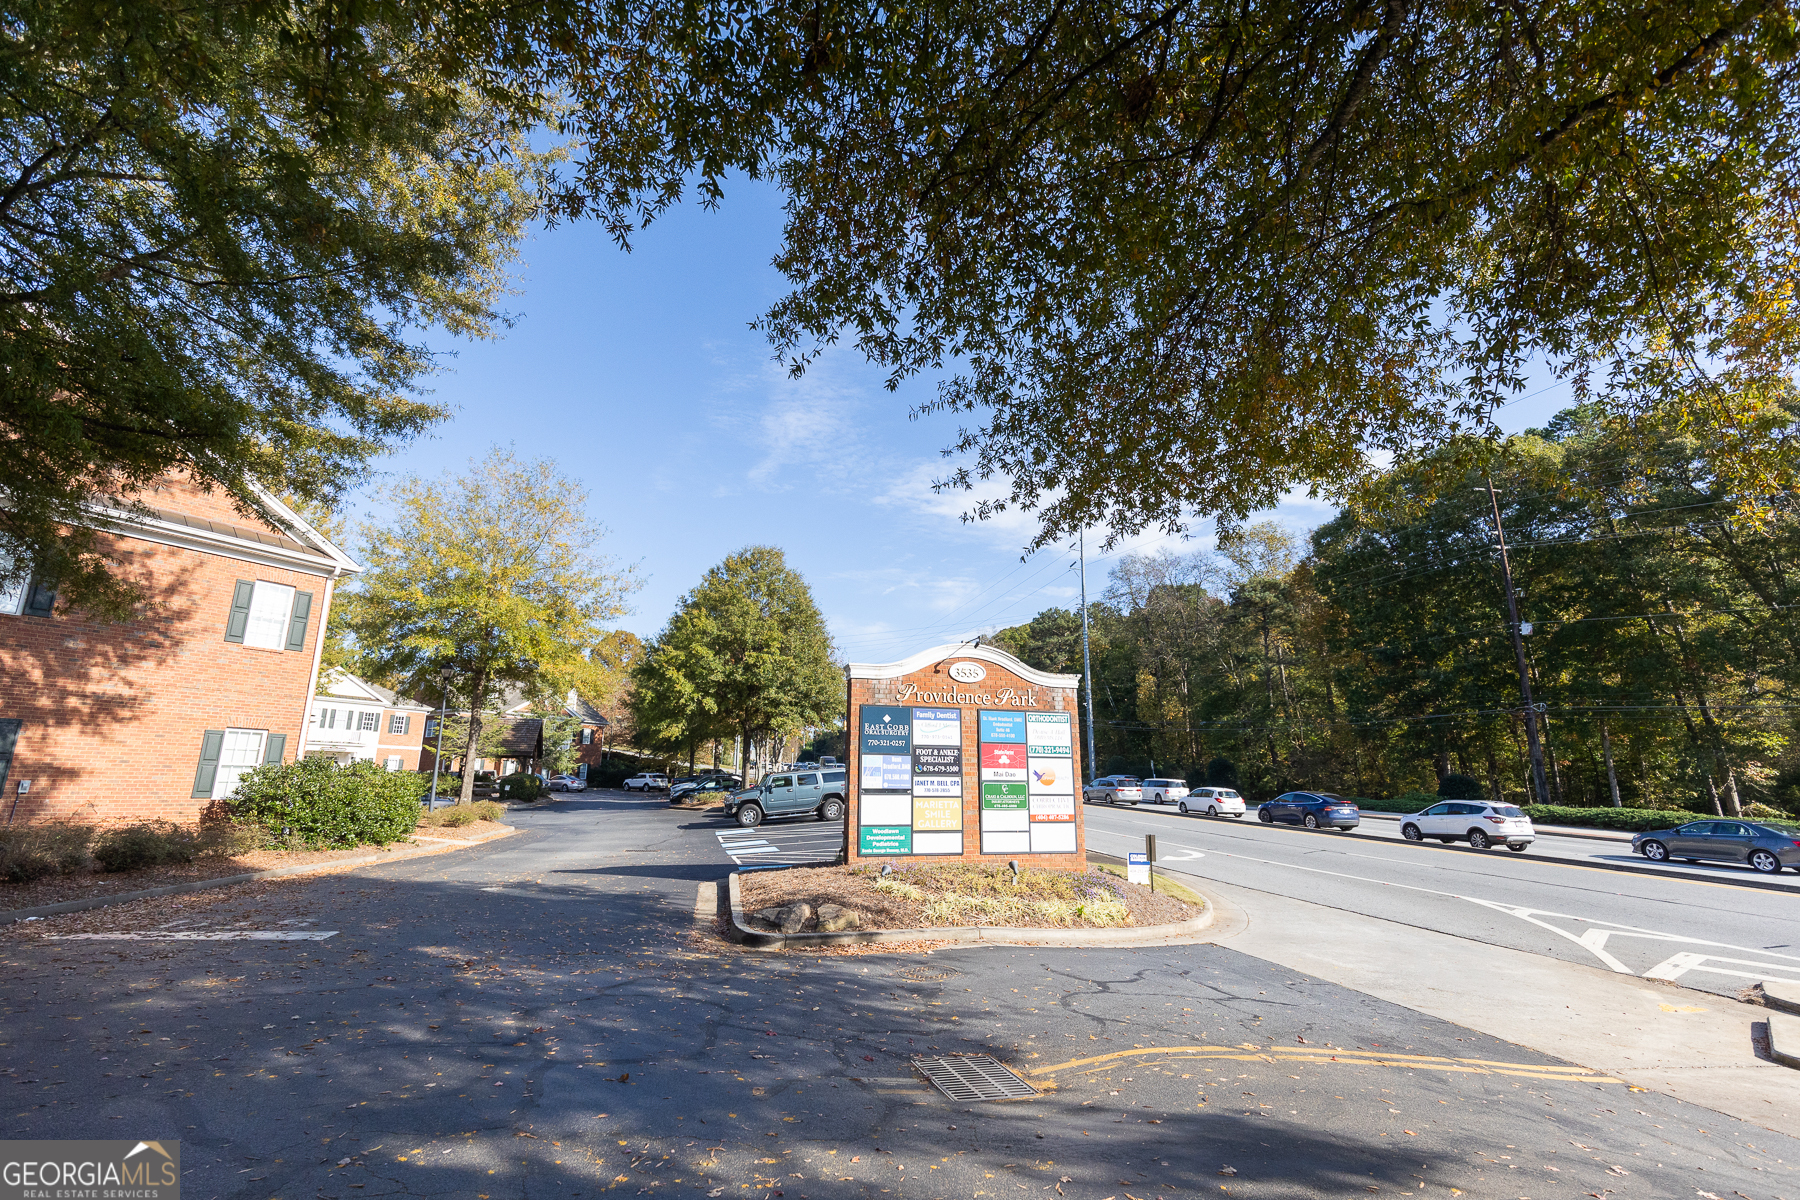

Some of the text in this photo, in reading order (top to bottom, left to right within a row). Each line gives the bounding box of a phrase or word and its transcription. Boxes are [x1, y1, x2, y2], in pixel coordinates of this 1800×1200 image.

[954, 667, 980, 678] 3535
[895, 683, 1038, 707] Providence Park
[916, 711, 935, 719] Family
[1028, 715, 1068, 723] ORTHODONTIST
[886, 723, 909, 731] COBB
[915, 801, 959, 809] MARIETTA
[924, 810, 951, 819] SMILE
[918, 820, 957, 828] GALLERY
